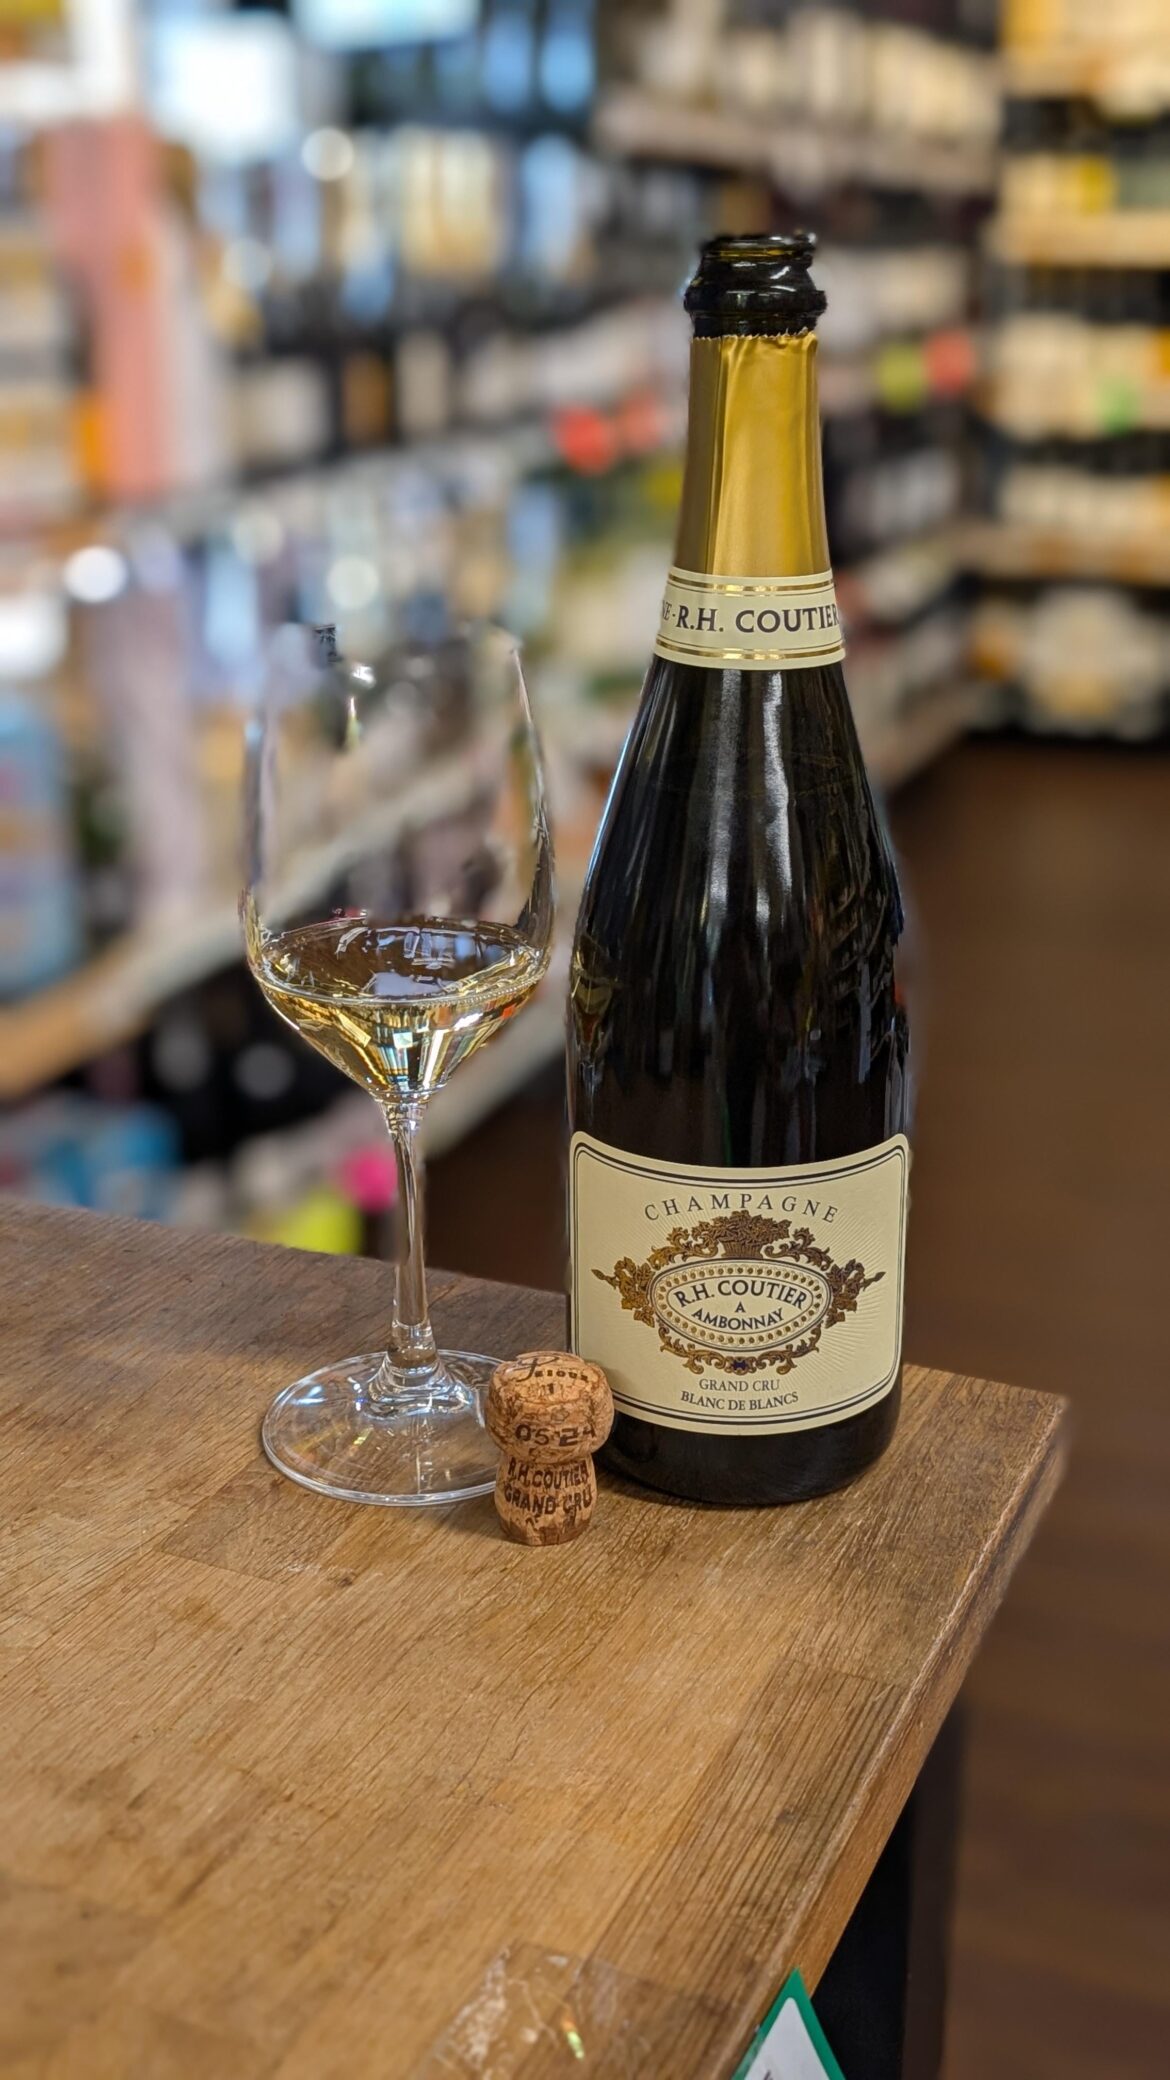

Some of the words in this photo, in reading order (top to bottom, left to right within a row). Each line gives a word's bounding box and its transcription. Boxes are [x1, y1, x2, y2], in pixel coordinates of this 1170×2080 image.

[735, 603, 840, 633] COUTIER
[644, 1193, 838, 1223] CHAMPAGNE
[674, 1282, 715, 1308] R.H.
[717, 1280, 807, 1310] COUTIER
[691, 1308, 784, 1331] AMBONNAY
[699, 1378, 749, 1392] GRAND
[752, 1379, 780, 1391] CRU
[680, 1390, 725, 1410] BLANC
[728, 1399, 746, 1411] DE
[749, 1391, 799, 1411] BLANCS
